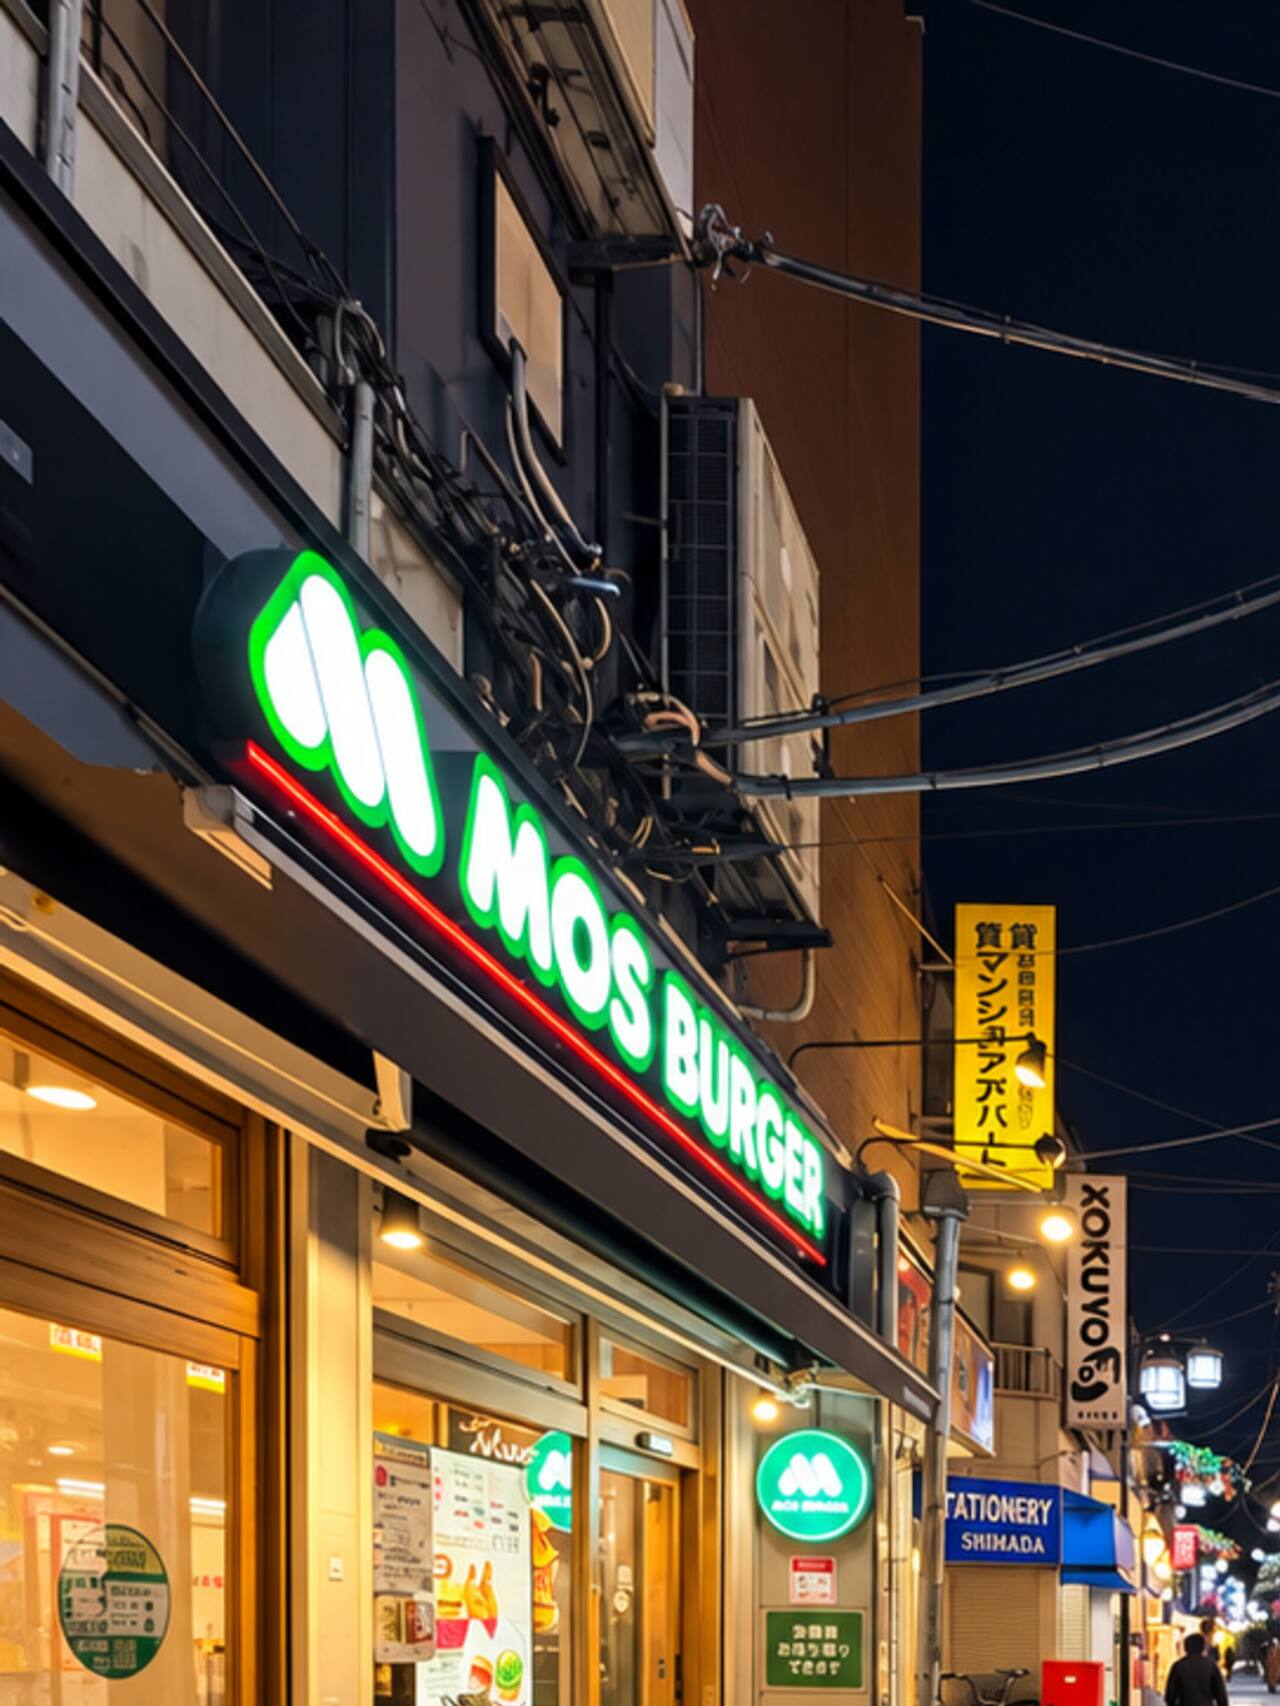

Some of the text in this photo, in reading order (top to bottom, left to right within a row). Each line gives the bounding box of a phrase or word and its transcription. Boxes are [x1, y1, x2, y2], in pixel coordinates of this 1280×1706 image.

[462, 764, 825, 1235] MOS BURGER
[945, 1491, 1053, 1526] TATIONERY
